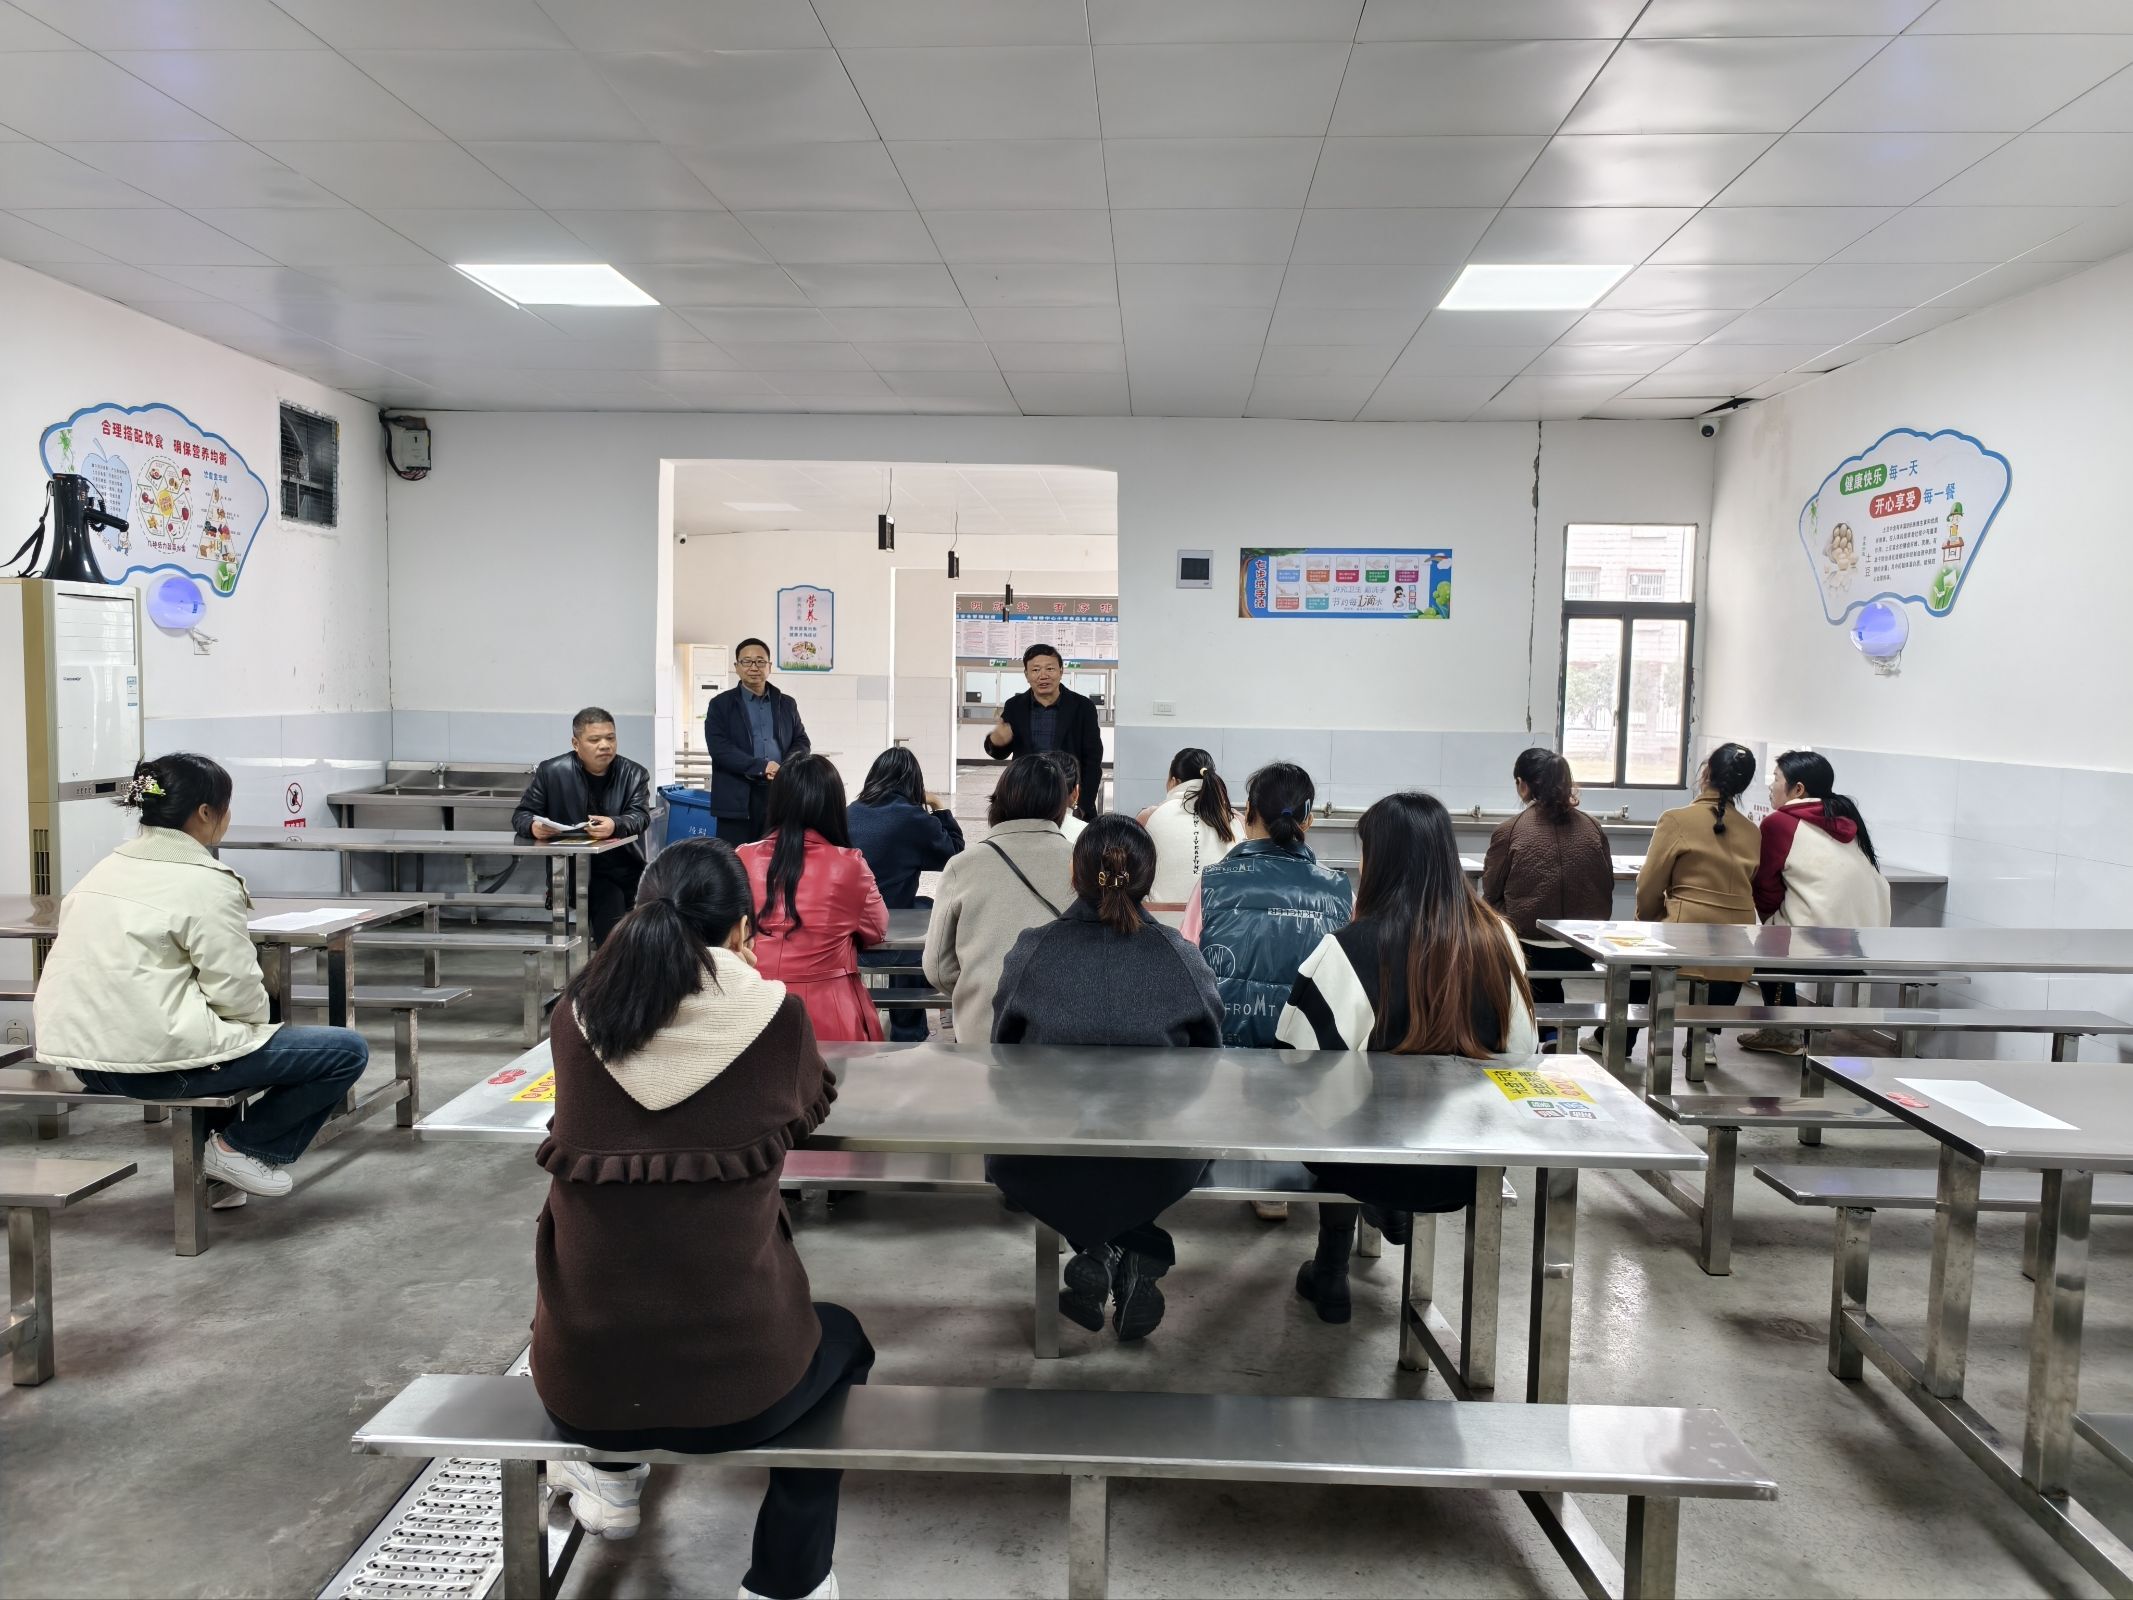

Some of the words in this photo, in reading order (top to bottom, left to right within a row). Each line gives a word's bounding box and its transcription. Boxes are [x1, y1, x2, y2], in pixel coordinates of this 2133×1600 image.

[101, 420, 163, 450] 合理搭配饮食
[173, 439, 227, 466] 确保营养均衡
[1844, 468, 1882, 492] 健康快乐
[1889, 460, 1918, 480] 每一天
[1875, 490, 1916, 515] 开心享受
[1923, 482, 1956, 504] 每一餐
[1254, 559, 1267, 609] 七步洗手法
[956, 600, 1030, 613] 明就餐
